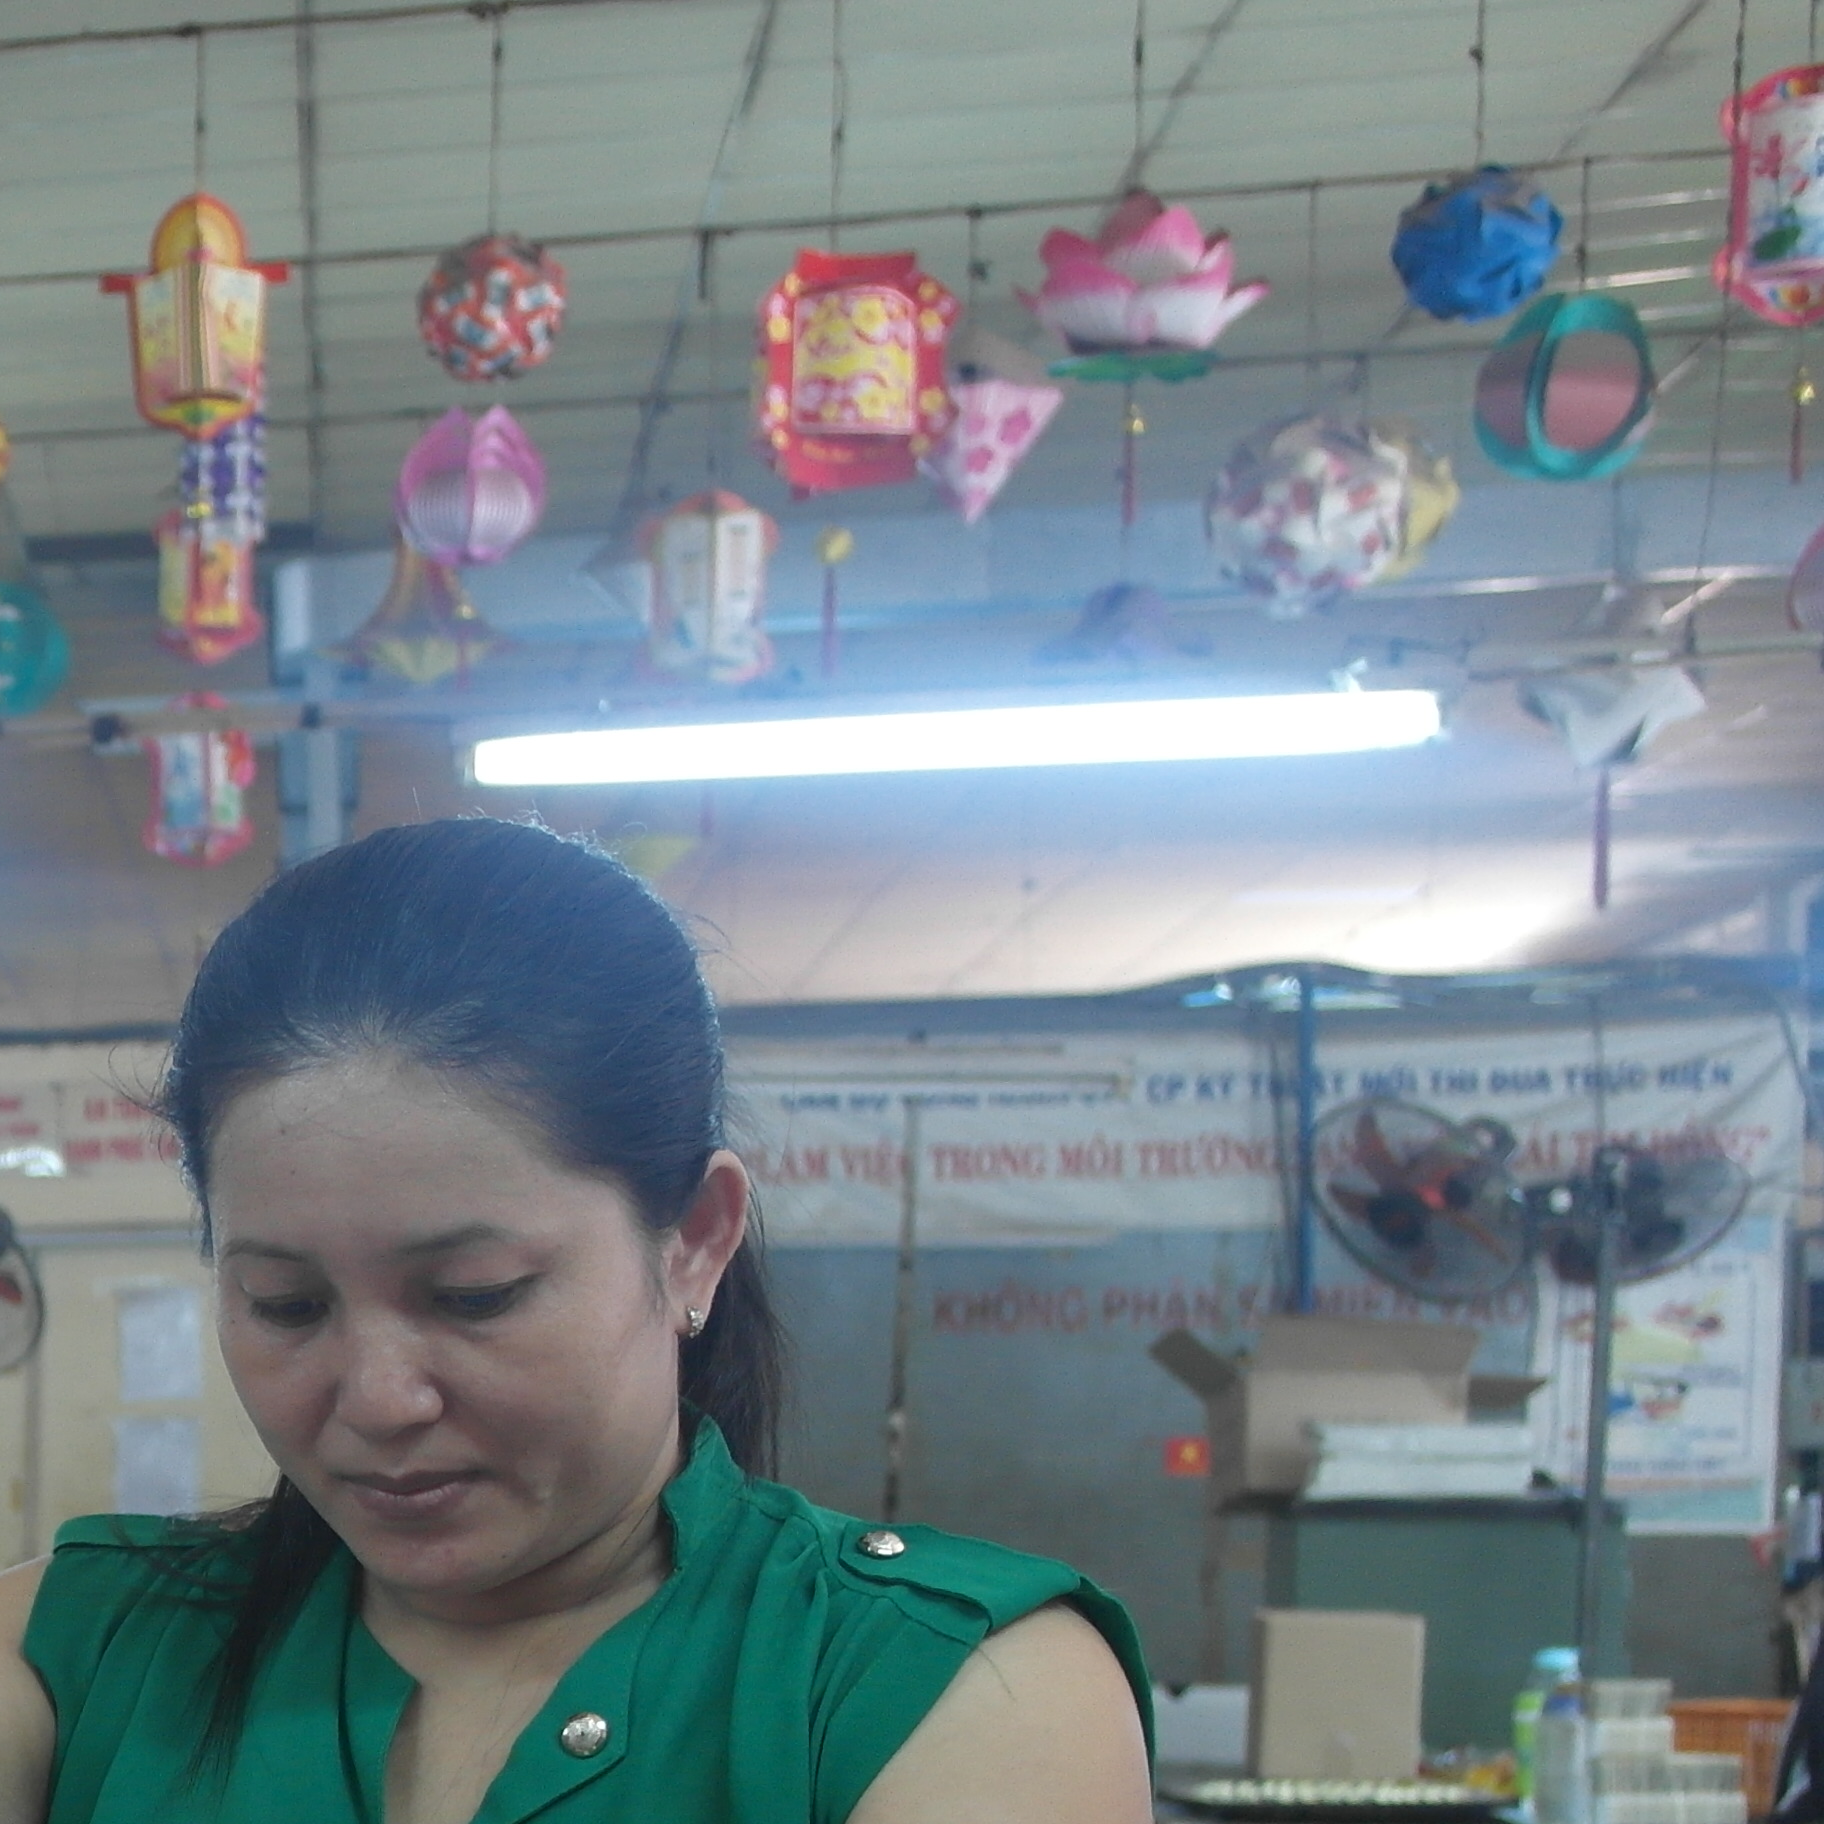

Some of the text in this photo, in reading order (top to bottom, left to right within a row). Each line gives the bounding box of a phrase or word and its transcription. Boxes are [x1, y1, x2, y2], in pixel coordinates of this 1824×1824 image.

[930, 1141, 1047, 1183] TRONG
[1058, 1129, 1123, 1178] MÔI
[932, 1276, 1090, 1335] KHÔNG
